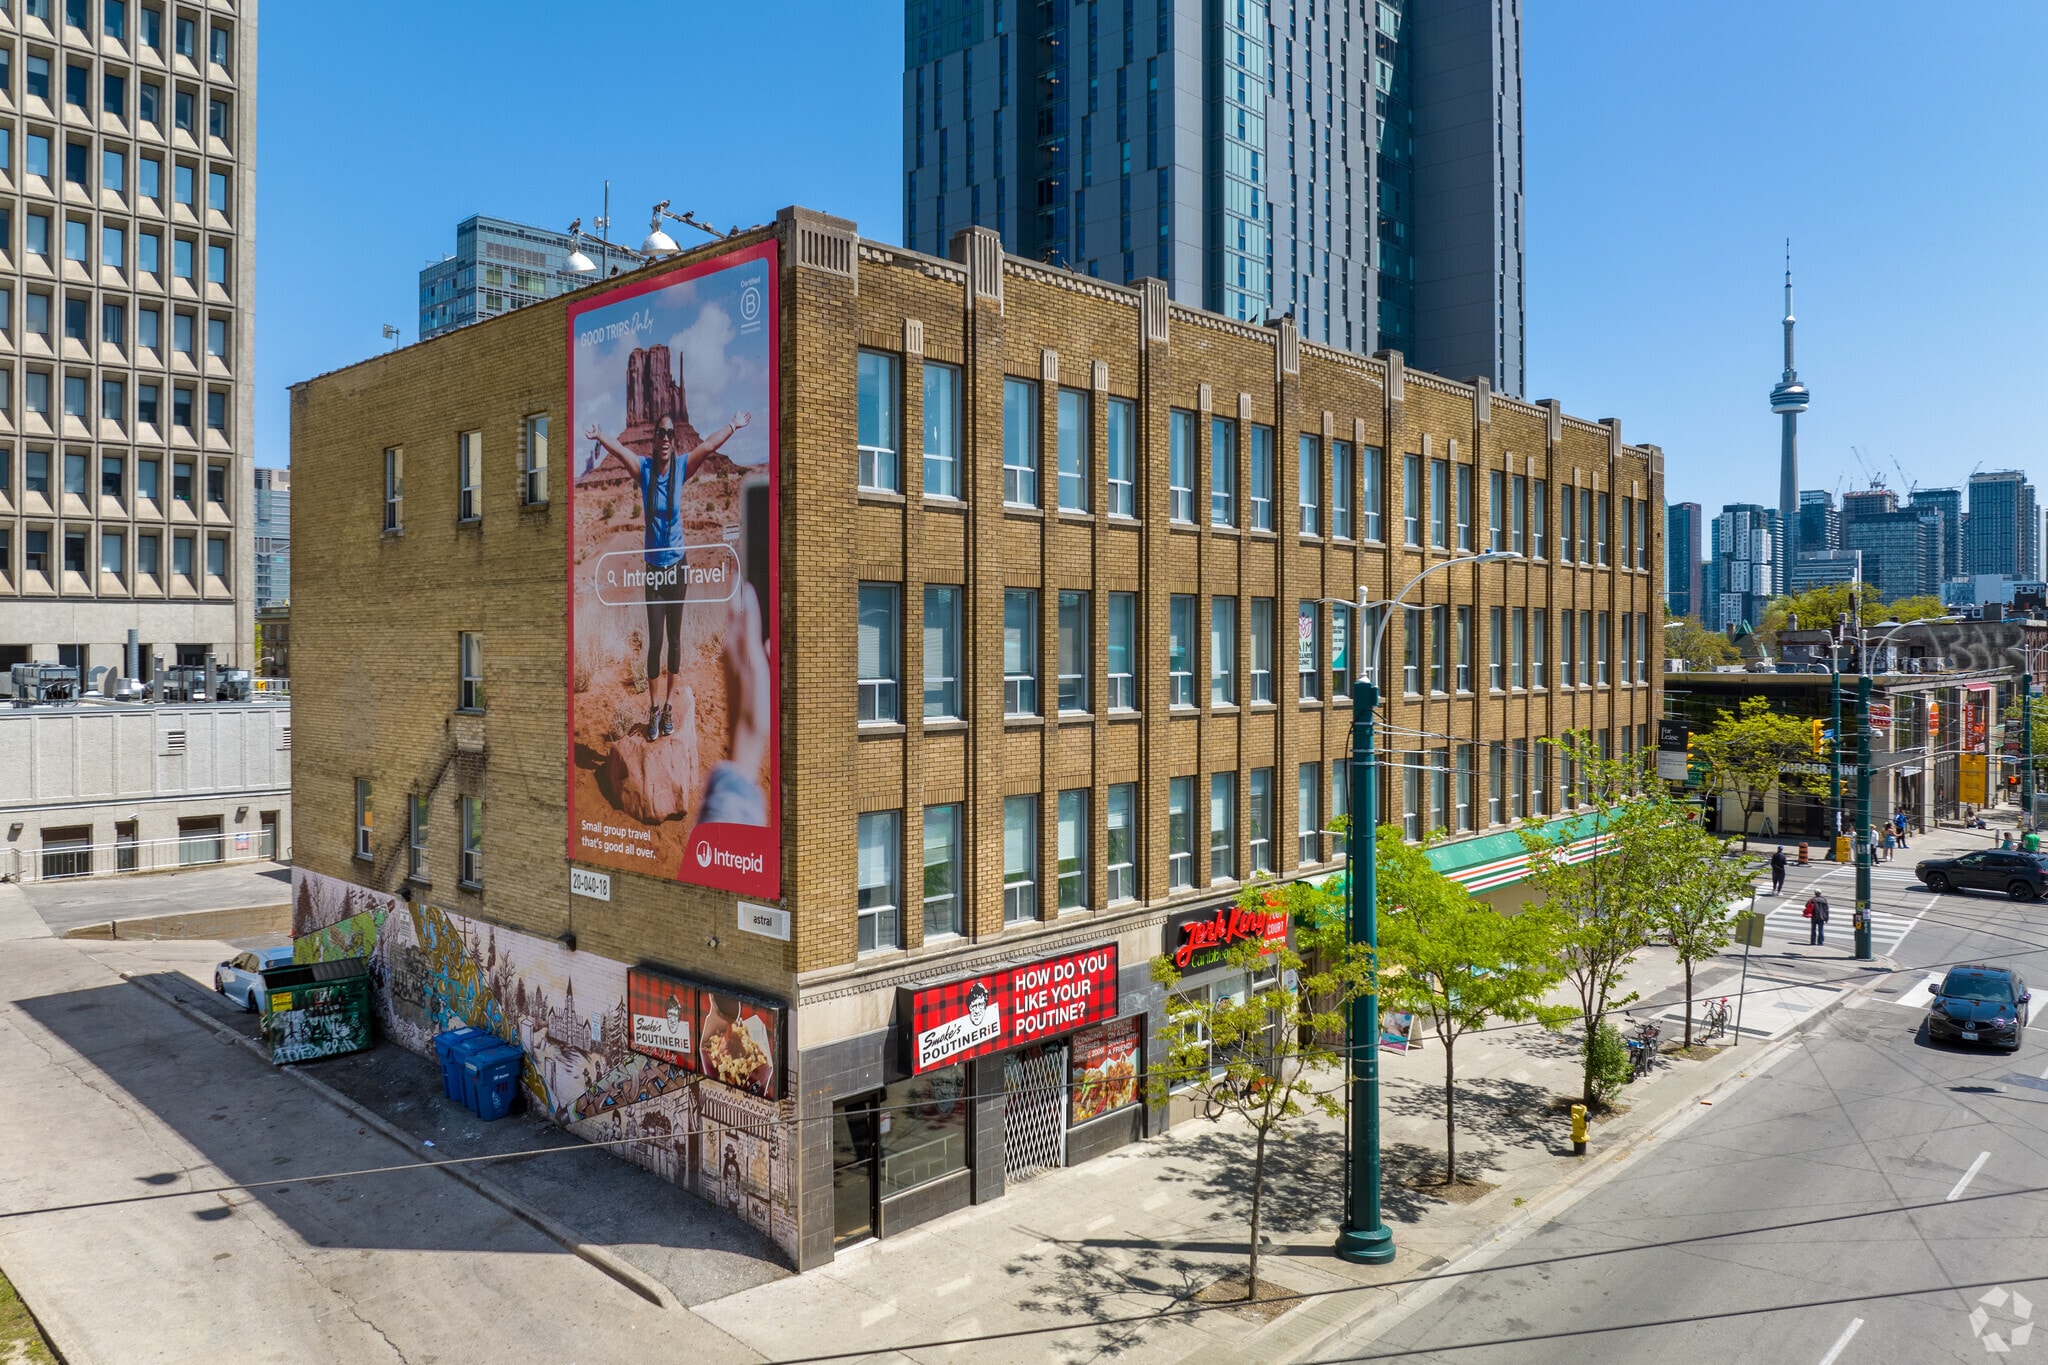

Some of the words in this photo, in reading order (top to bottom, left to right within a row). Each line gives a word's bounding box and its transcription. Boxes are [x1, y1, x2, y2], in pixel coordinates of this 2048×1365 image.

[580, 327, 605, 348] GOOD
[606, 320, 630, 340] TRIPS
[631, 308, 654, 335] Only
[623, 564, 677, 591] Intrepid
[681, 561, 725, 585] Travel
[1661, 733, 1679, 741] Lease
[581, 819, 602, 833] Small
[603, 825, 626, 839] group
[628, 828, 651, 841] travel
[581, 836, 602, 849] that's
[604, 841, 623, 853] good
[625, 844, 634, 855] all
[636, 847, 656, 859] over.
[714, 847, 763, 874] Intrepid
[573, 873, 608, 896] 20-040-18
[753, 915, 773, 927] astral
[1267, 920, 1284, 936] COURT
[1176, 909, 1226, 968] Jerk
[1226, 906, 1266, 944] King
[1191, 948, 1231, 968] Caribbea
[1015, 967, 1050, 993] HOW
[1054, 962, 1075, 982] DO
[1078, 953, 1108, 976] YOU
[1015, 991, 1049, 1015] LIKE
[1051, 979, 1091, 1004] YOUR
[636, 1017, 662, 1032] Smoke's
[1015, 1001, 1086, 1037] POUTINE?
[923, 1022, 962, 1051] Smoke's
[1107, 1031, 1116, 1039] ON
[1107, 1037, 1125, 1048] SHARE
[1126, 1032, 1139, 1042] WITH
[1113, 1042, 1133, 1055] FRIEND!
[752, 1202, 766, 1222] NEW
